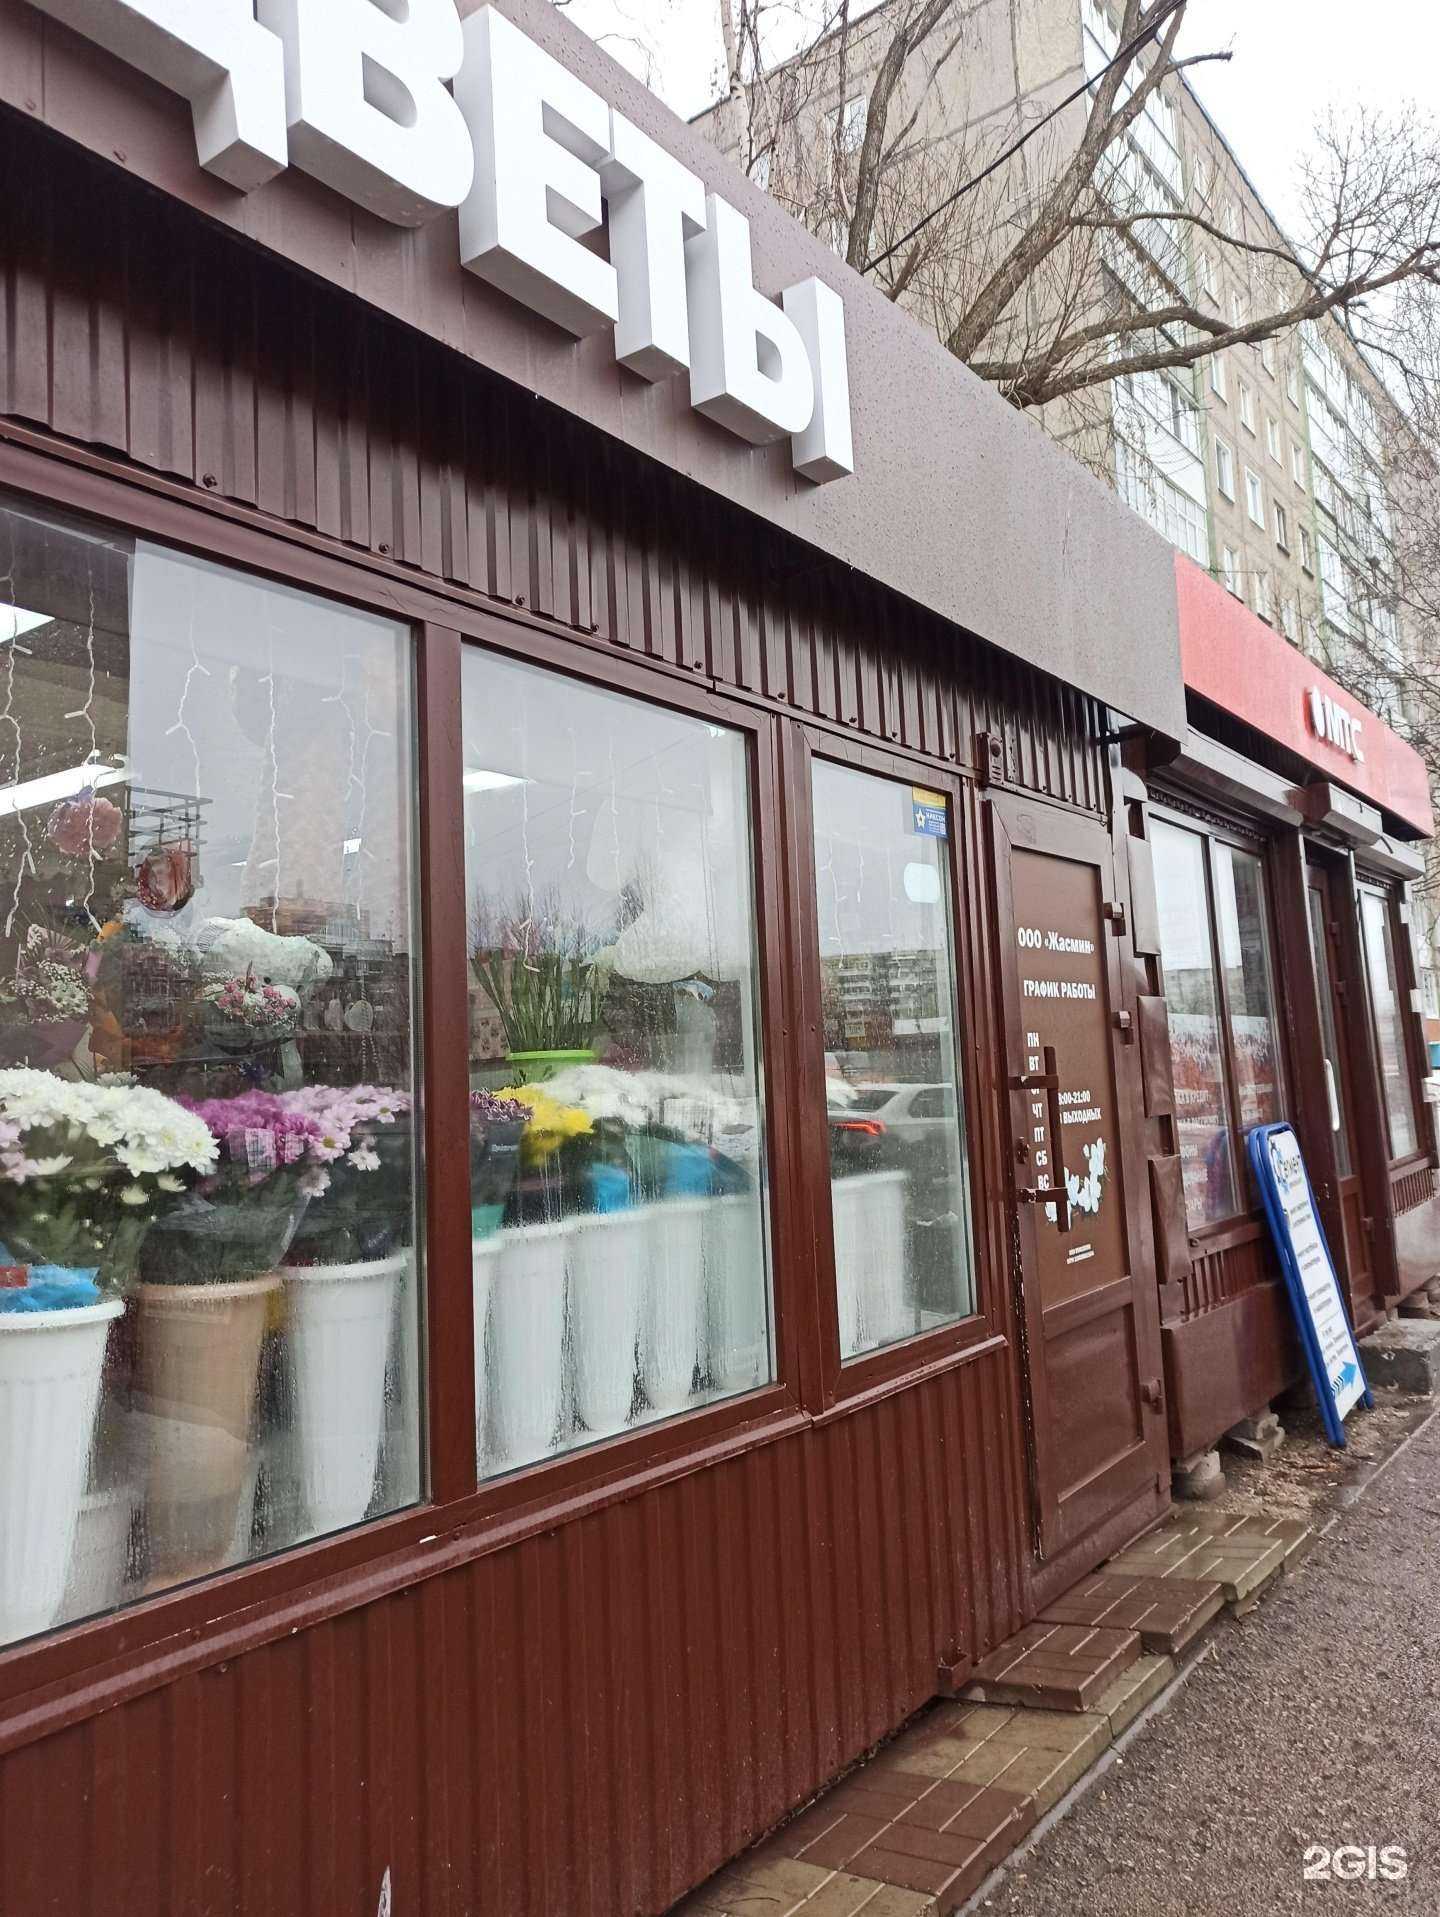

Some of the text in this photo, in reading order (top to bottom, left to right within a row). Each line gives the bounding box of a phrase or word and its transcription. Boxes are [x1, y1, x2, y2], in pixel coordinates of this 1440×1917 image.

[28, 0, 854, 482] ВЕТЫ
[1018, 927, 1095, 955] ООО «Жасмин»
[1023, 980, 1096, 1000] ГРАФИК РАБОТЫ
[1027, 1032, 1040, 1048] ПН
[1028, 1056, 1040, 1071] ВТ
[1032, 1103, 1043, 1119] ЧТ
[1063, 1107, 1102, 1125] ВЫХОДНЫХ
[1034, 1126, 1045, 1143] ПТ
[1036, 1150, 1048, 1167] СБ
[1037, 1174, 1050, 1191] ВС
